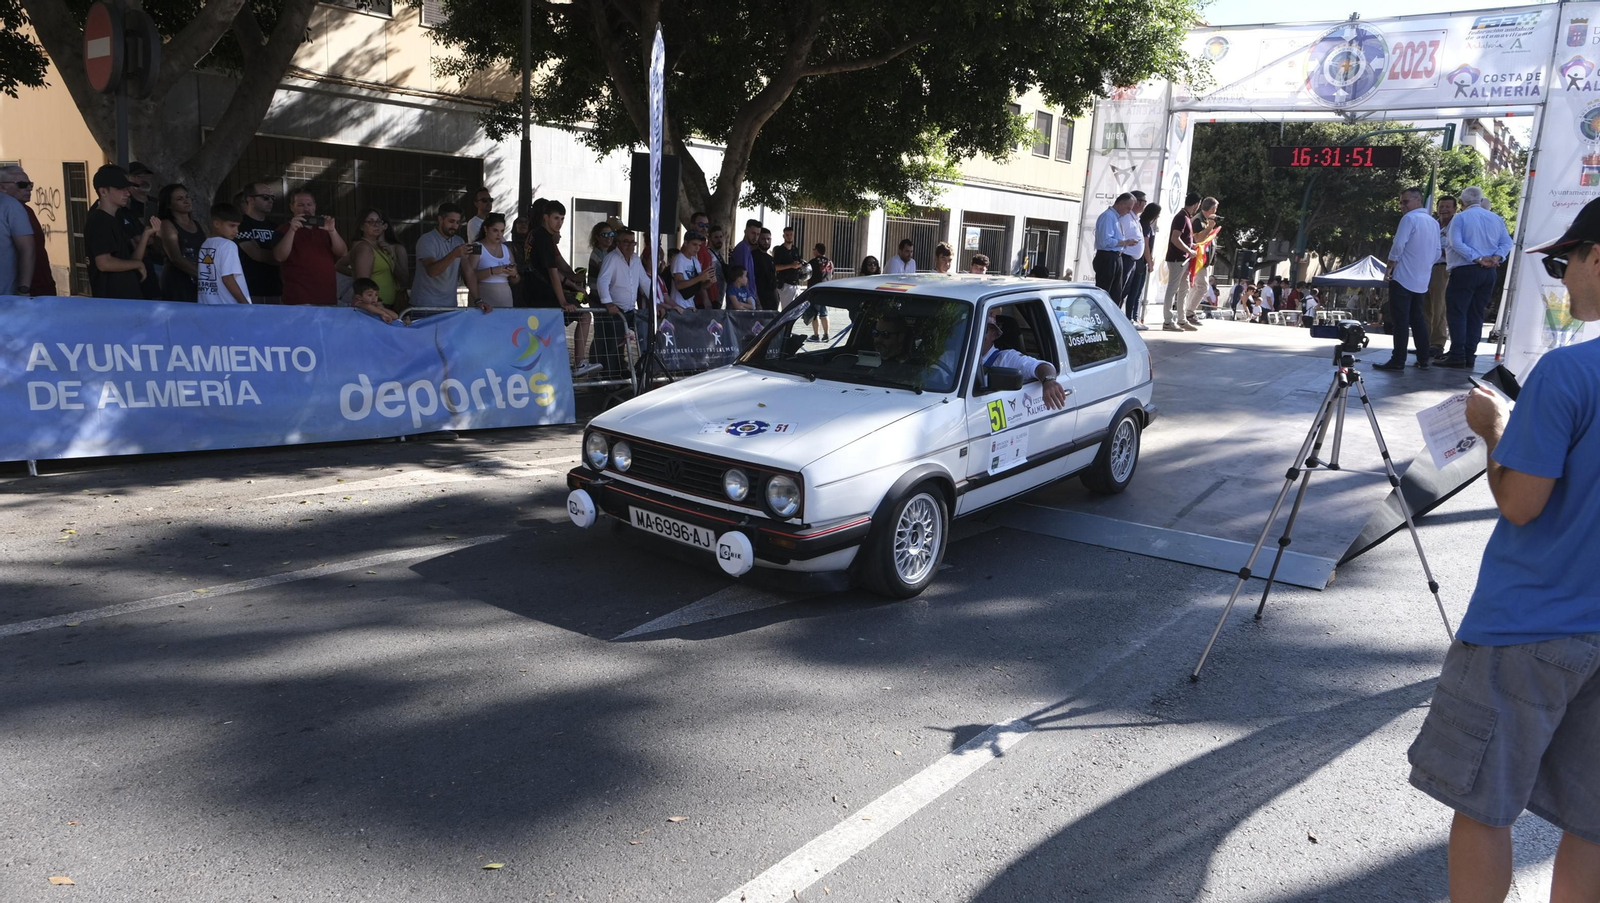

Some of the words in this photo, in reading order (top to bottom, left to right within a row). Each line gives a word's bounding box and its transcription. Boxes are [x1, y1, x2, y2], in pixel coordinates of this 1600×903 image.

[1387, 39, 1441, 80] 2023
[1469, 81, 1541, 98] ALMERÍA
[1483, 73, 1523, 84] COSTA
[1525, 72, 1542, 81] DE
[1290, 147, 1373, 167] 16:31:51
[1548, 189, 1597, 197] Ayuntamiento
[25, 342, 317, 373] AYUNTAMIENTO
[27, 380, 85, 411] DE
[97, 374, 262, 410] ALMERÍA
[339, 368, 556, 429] deportes
[774, 423, 790, 433] 51
[987, 399, 1007, 432] 51
